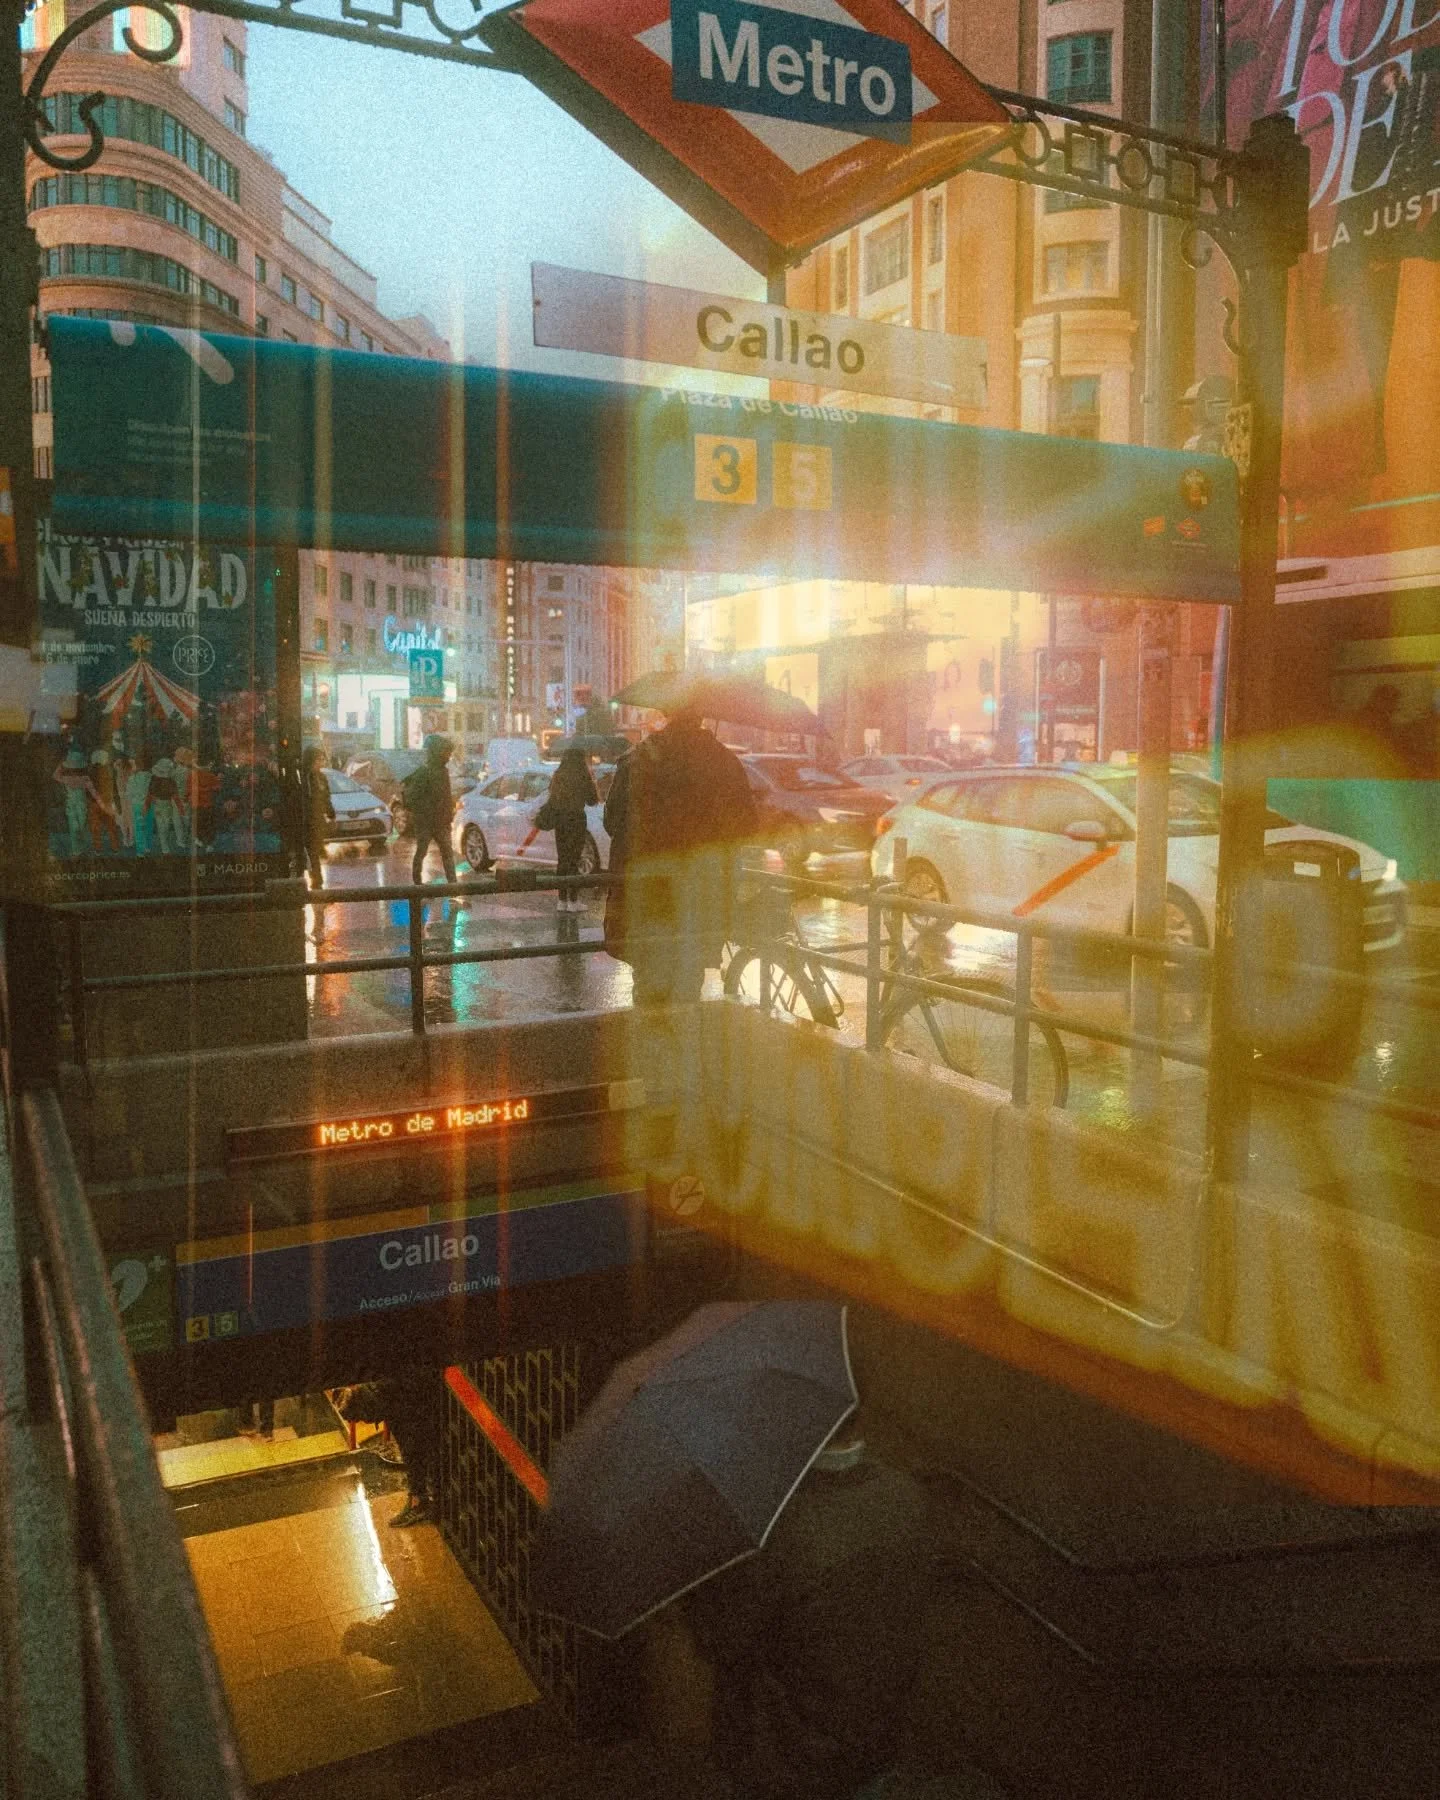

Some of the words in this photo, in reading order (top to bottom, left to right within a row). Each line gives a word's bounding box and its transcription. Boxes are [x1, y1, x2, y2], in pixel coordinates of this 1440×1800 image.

[698, 11, 896, 116] Metro
[1313, 222, 1351, 254] LA
[696, 304, 866, 375] Callao
[711, 444, 742, 495] 3
[789, 451, 818, 501] 5
[37, 545, 249, 613] NAVIDAD
[132, 611, 197, 628] DESPIERTO
[214, 862, 269, 875] MADRID
[319, 1120, 394, 1146] Metro
[406, 1113, 435, 1134] de
[446, 1098, 529, 1129] Madrid
[379, 1233, 480, 1271] Callao
[448, 1279, 480, 1295] Gran
